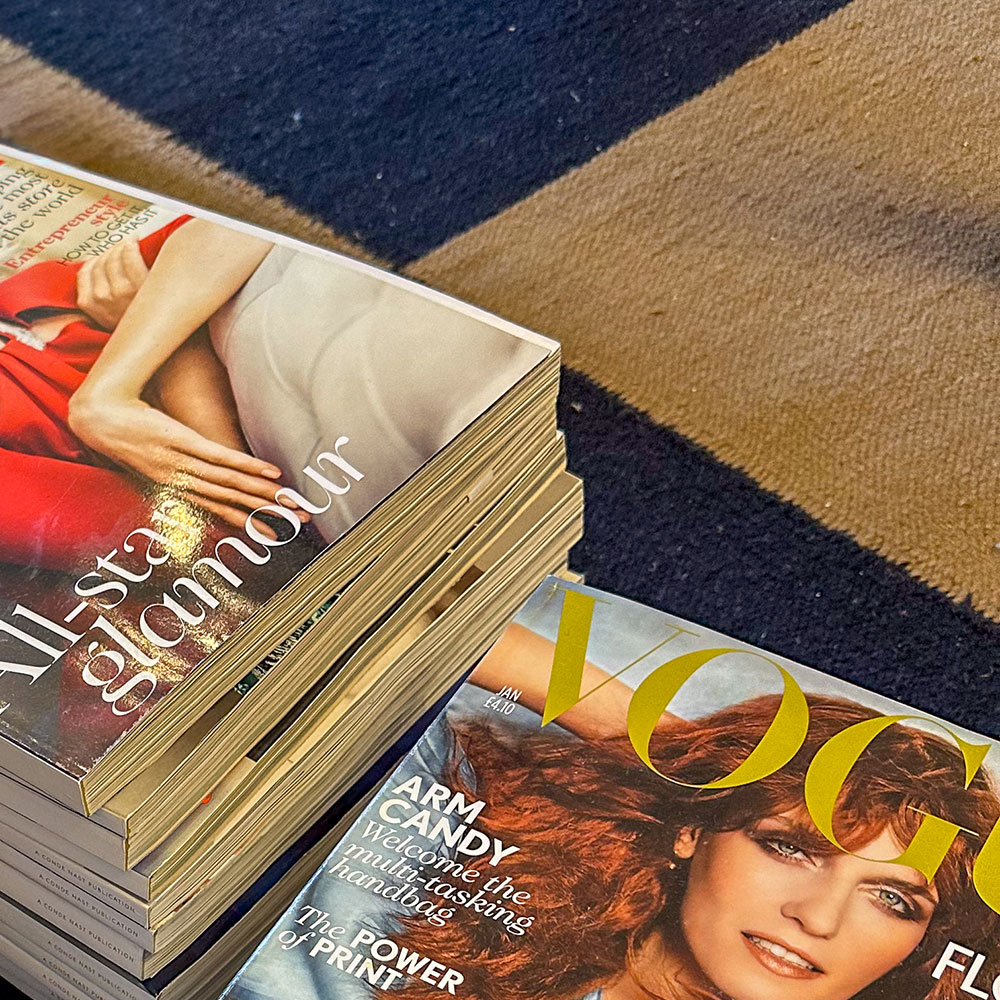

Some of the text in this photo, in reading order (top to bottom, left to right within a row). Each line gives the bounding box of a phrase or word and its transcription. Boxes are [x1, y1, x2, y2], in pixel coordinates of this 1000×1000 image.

[1, 217, 34, 246] the
[34, 183, 84, 220] world
[3, 172, 49, 206] most
[18, 178, 66, 213] store
[90, 199, 130, 227] style
[3, 194, 112, 270] Entrepreneur
[56, 242, 91, 267] HOW
[89, 230, 109, 245] TO
[107, 212, 132, 231] GET
[87, 208, 158, 257] WHO HAS IT
[82, 435, 365, 716] glamour
[484, 698, 517, 716] £4.10
[496, 685, 522, 702] JAN
[541, 584, 1000, 915] VOG
[392, 775, 486, 825] ARM
[379, 799, 520, 867] CANDY
[344, 843, 536, 937] multi-tasking
[360, 819, 532, 906] Welcome the
[88, 881, 136, 914] PUBLICATION
[328, 857, 456, 927] handbag
[88, 930, 136, 963] PUBLICATION
[91, 905, 139, 938] PUBLICATION
[278, 929, 404, 991] of PRINT
[294, 904, 465, 996] The POWER
